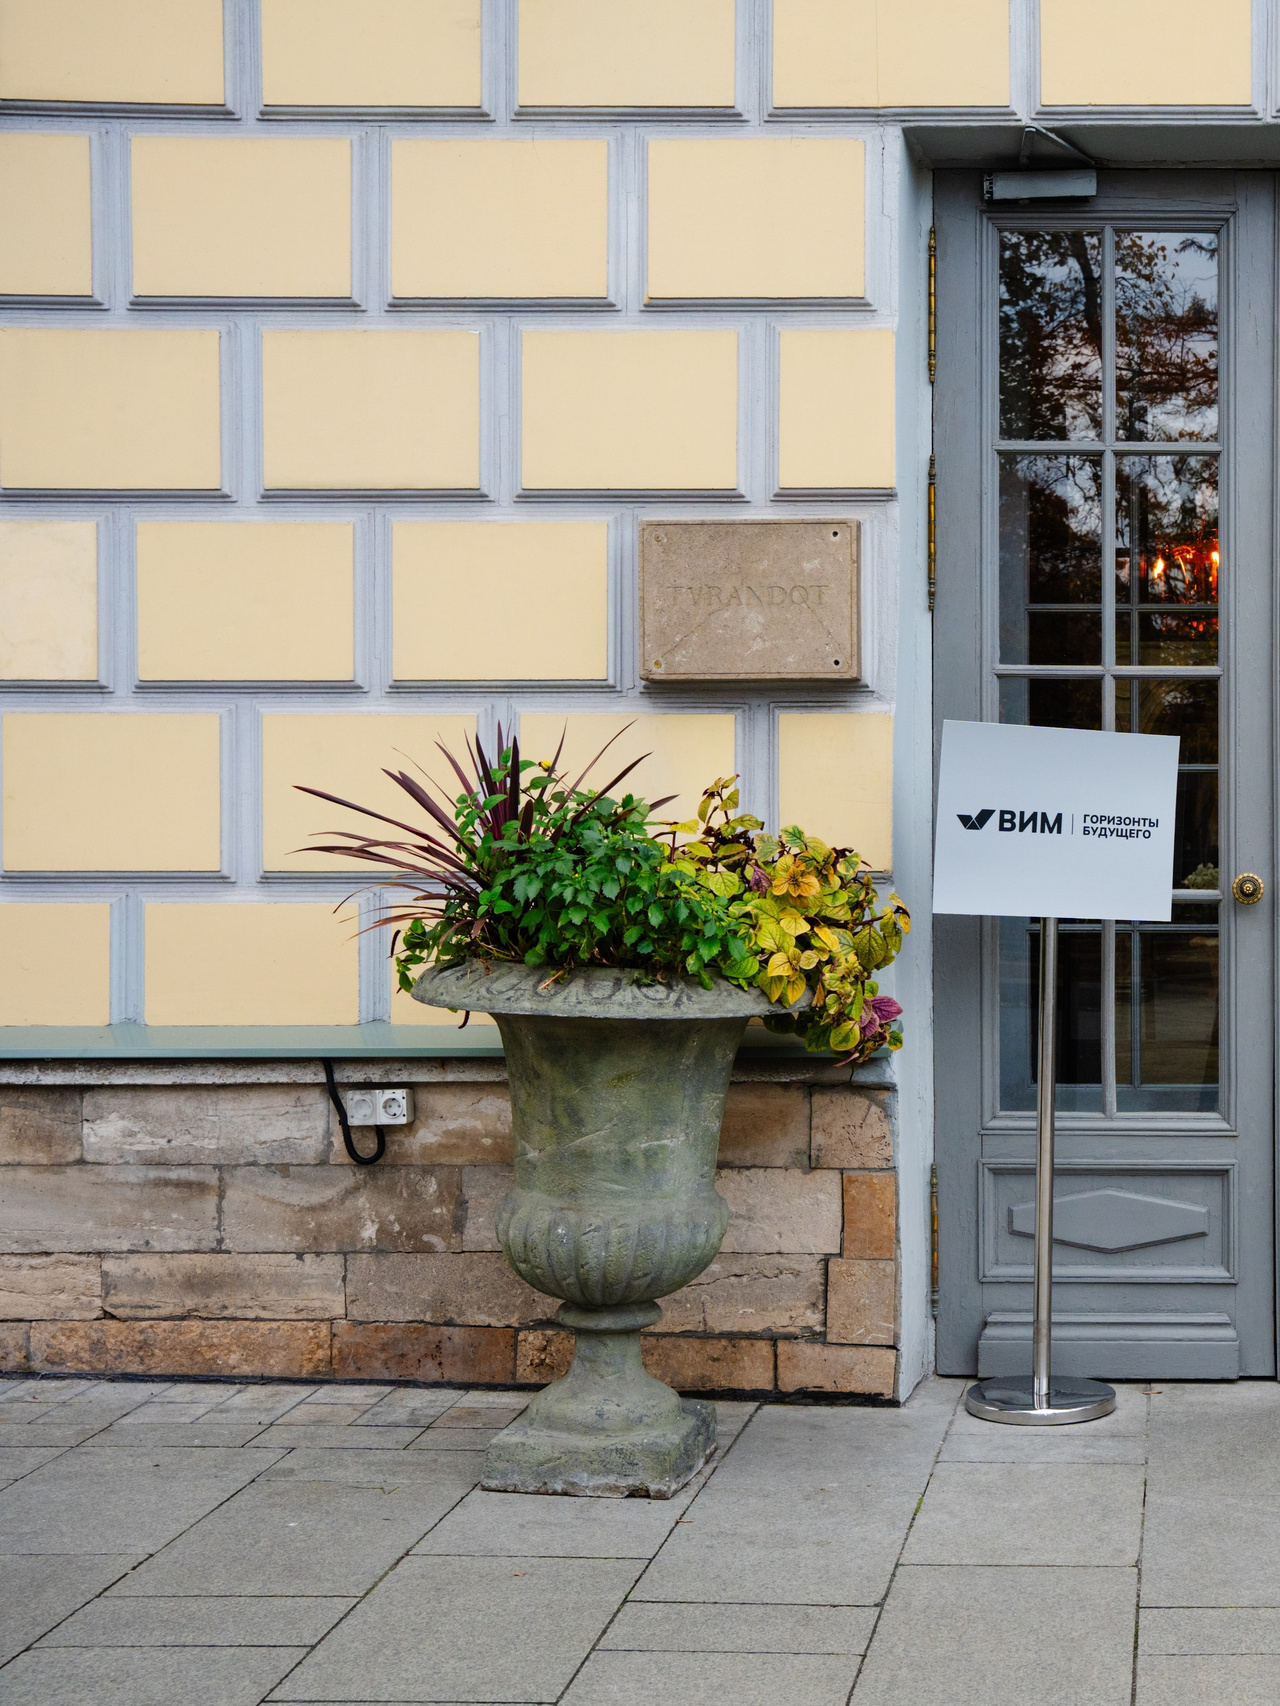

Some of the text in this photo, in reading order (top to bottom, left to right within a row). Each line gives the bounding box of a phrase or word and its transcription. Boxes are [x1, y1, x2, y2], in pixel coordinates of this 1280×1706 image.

[998, 809, 1063, 835] ВИМ
[1082, 814, 1159, 828] ГОРИЗОНТЫ
[1082, 826, 1151, 840] БУДУЩЕГО
